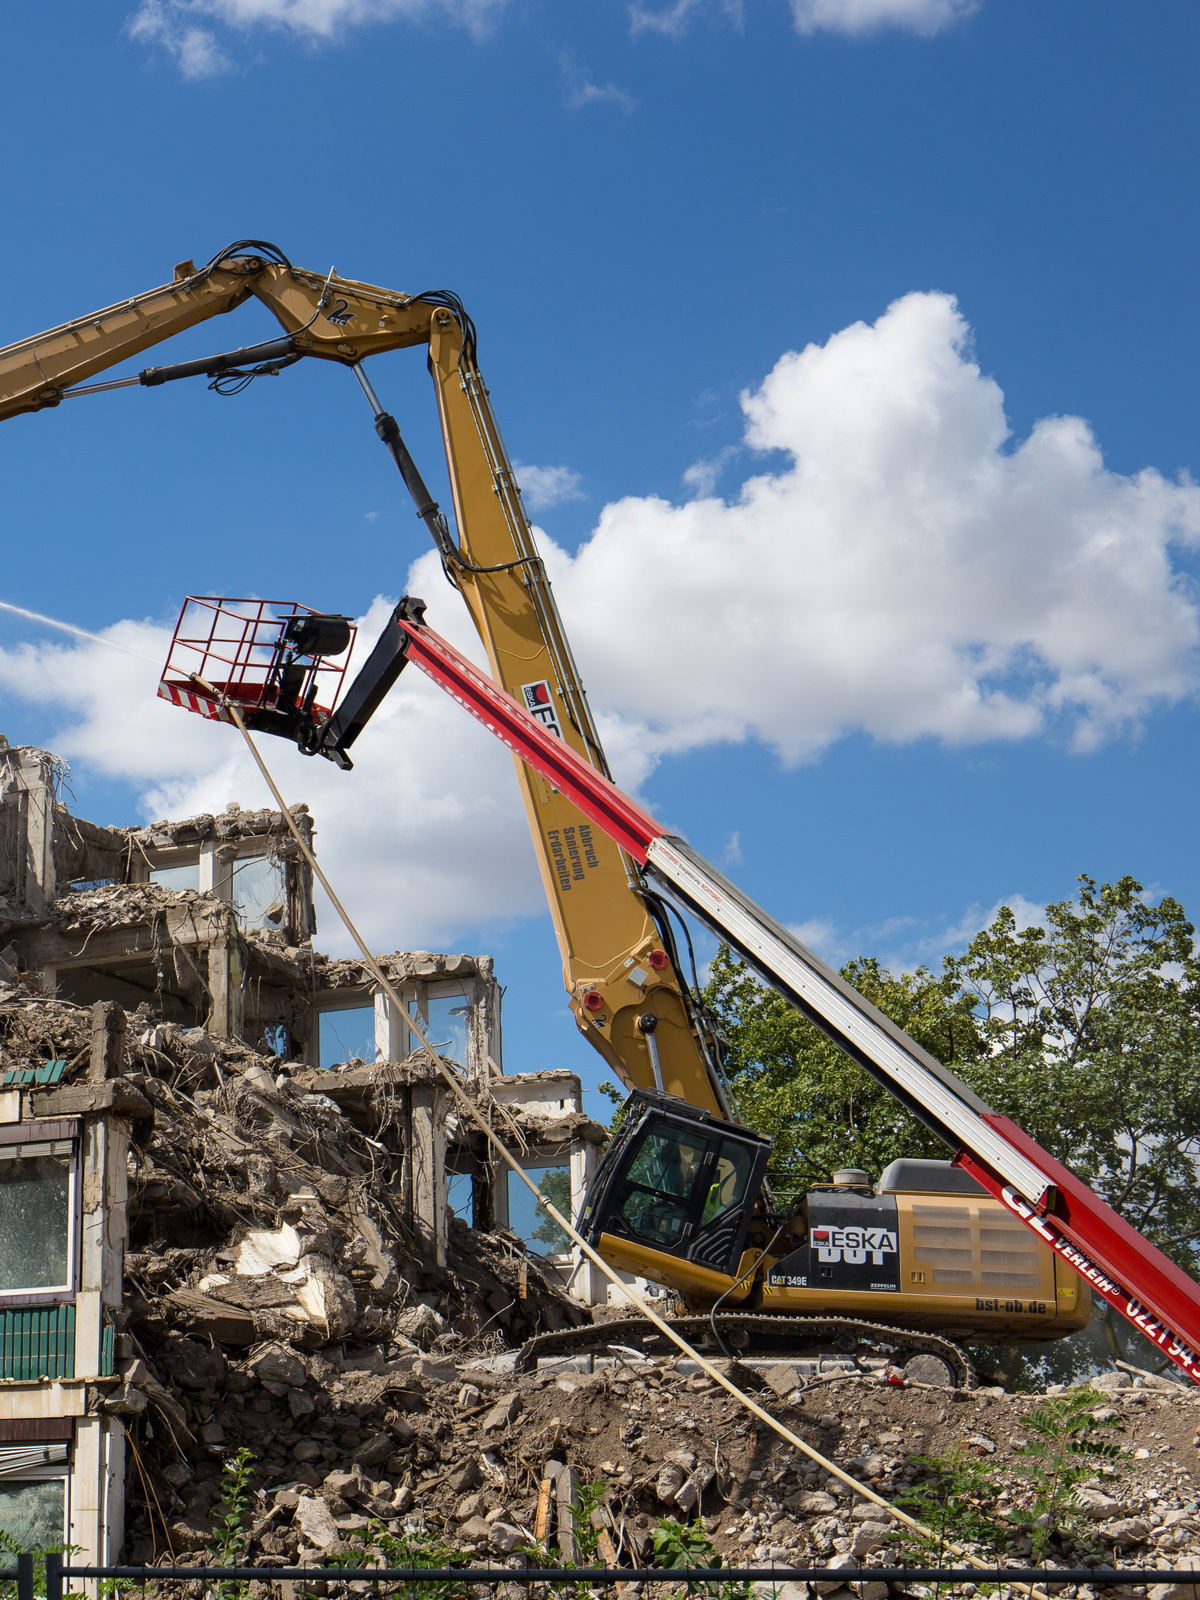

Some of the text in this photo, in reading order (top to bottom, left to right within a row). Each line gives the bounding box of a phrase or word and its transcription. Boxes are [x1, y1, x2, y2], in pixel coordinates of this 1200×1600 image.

[525, 687, 536, 707] ESKA
[563, 827, 585, 881] Sanierung
[578, 825, 599, 868] Abbruch
[547, 830, 572, 891] Erdarbeiten
[701, 883, 722, 903] ACHTUNG!
[831, 1231, 895, 1250] ESKA
[1002, 1186, 1054, 1242] GL
[1126, 1297, 1170, 1344] 0221
[771, 1275, 807, 1286] CAT 349E
[975, 1298, 1047, 1314] bst-ob.de
